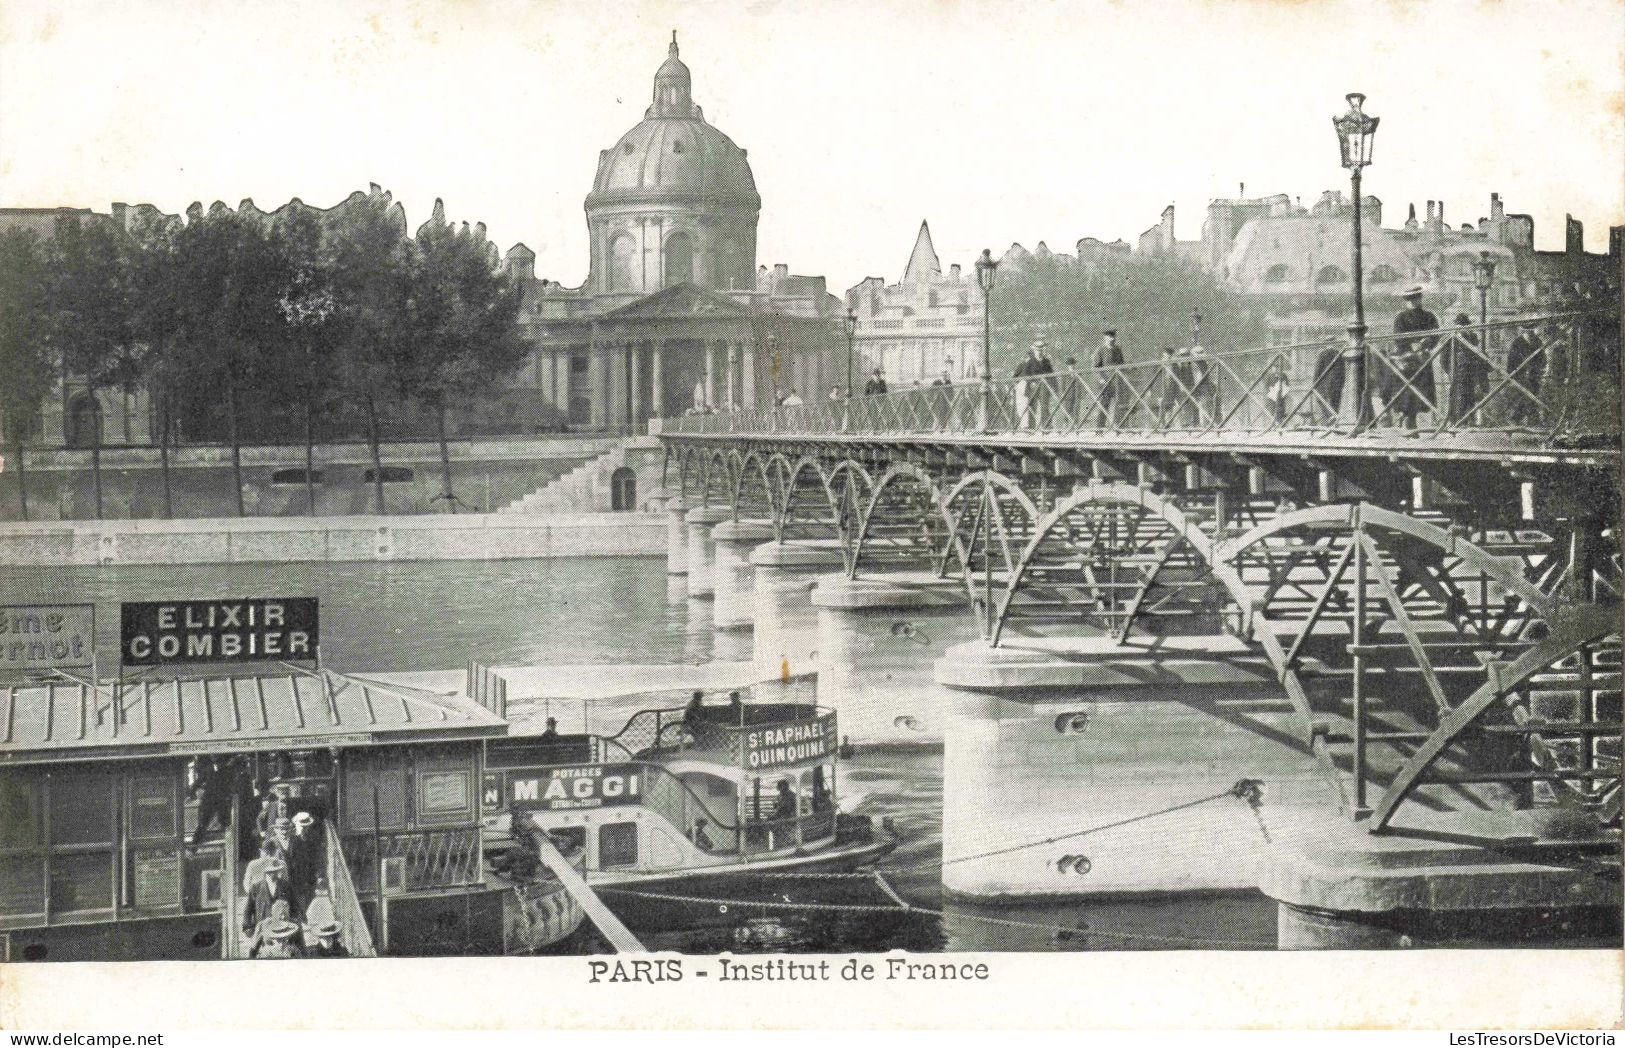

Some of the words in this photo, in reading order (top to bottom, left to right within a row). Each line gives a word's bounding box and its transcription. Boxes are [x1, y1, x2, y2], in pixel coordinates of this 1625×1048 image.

[159, 604, 285, 629] ELIXIR
[0, 634, 84, 661] rnot
[130, 631, 310, 659] COMBIER
[765, 723, 825, 746] RAPHAEL
[749, 740, 825, 767] QUINQUINA
[552, 767, 602, 779] POTAGES
[514, 775, 638, 800] MAGGI
